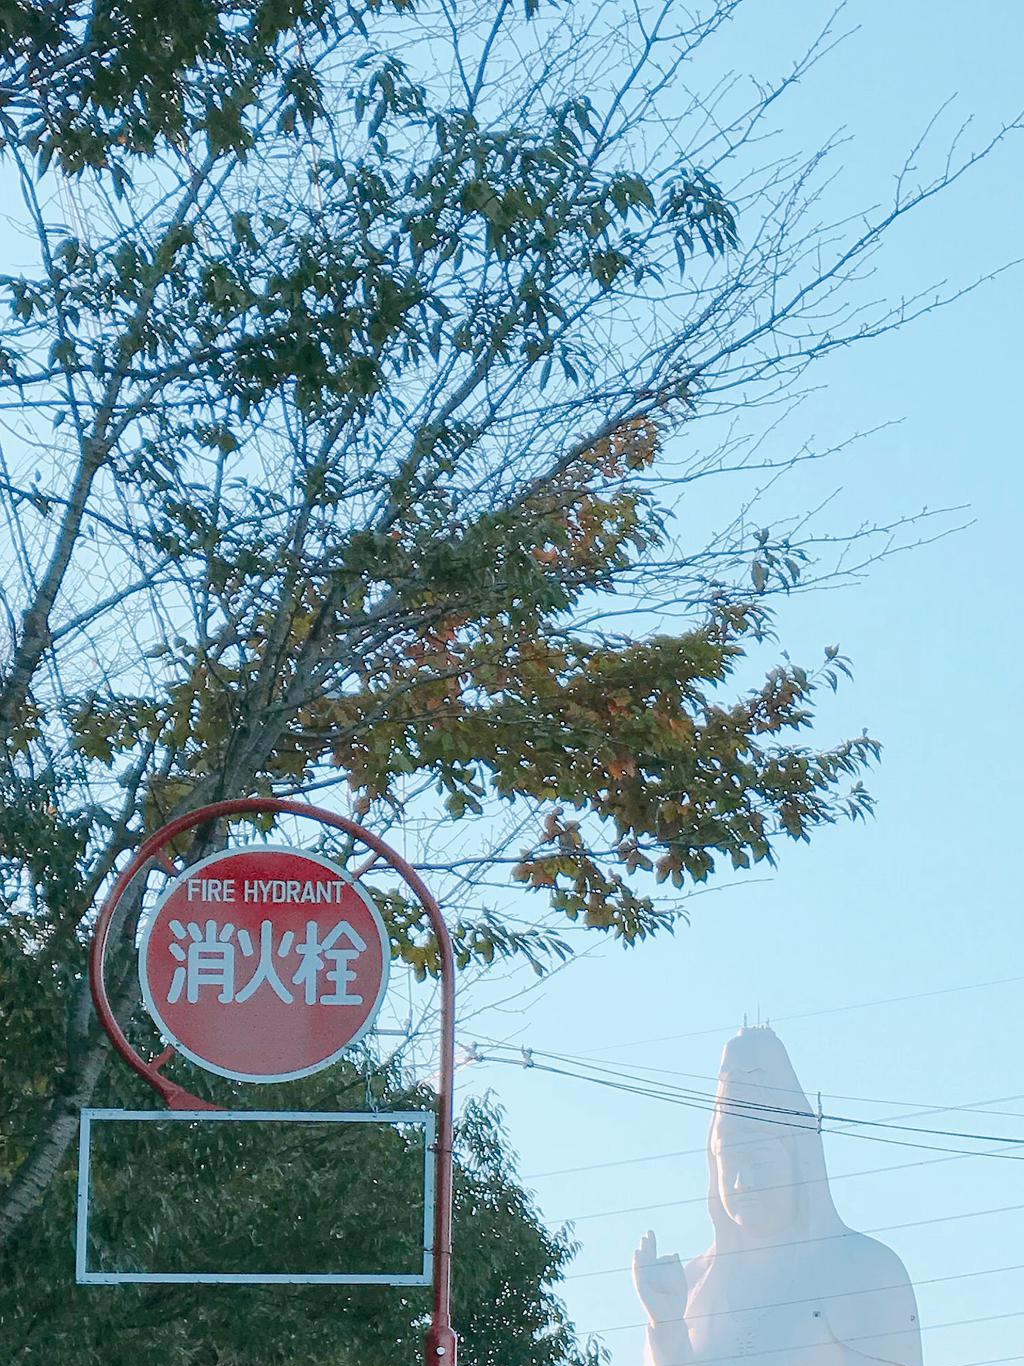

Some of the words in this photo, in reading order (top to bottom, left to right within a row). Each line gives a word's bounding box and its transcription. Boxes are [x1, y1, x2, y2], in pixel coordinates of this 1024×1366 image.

[187, 879, 235, 902] FIRE
[244, 880, 345, 904] HYDRANT
[167, 920, 367, 1006] 消火栓
